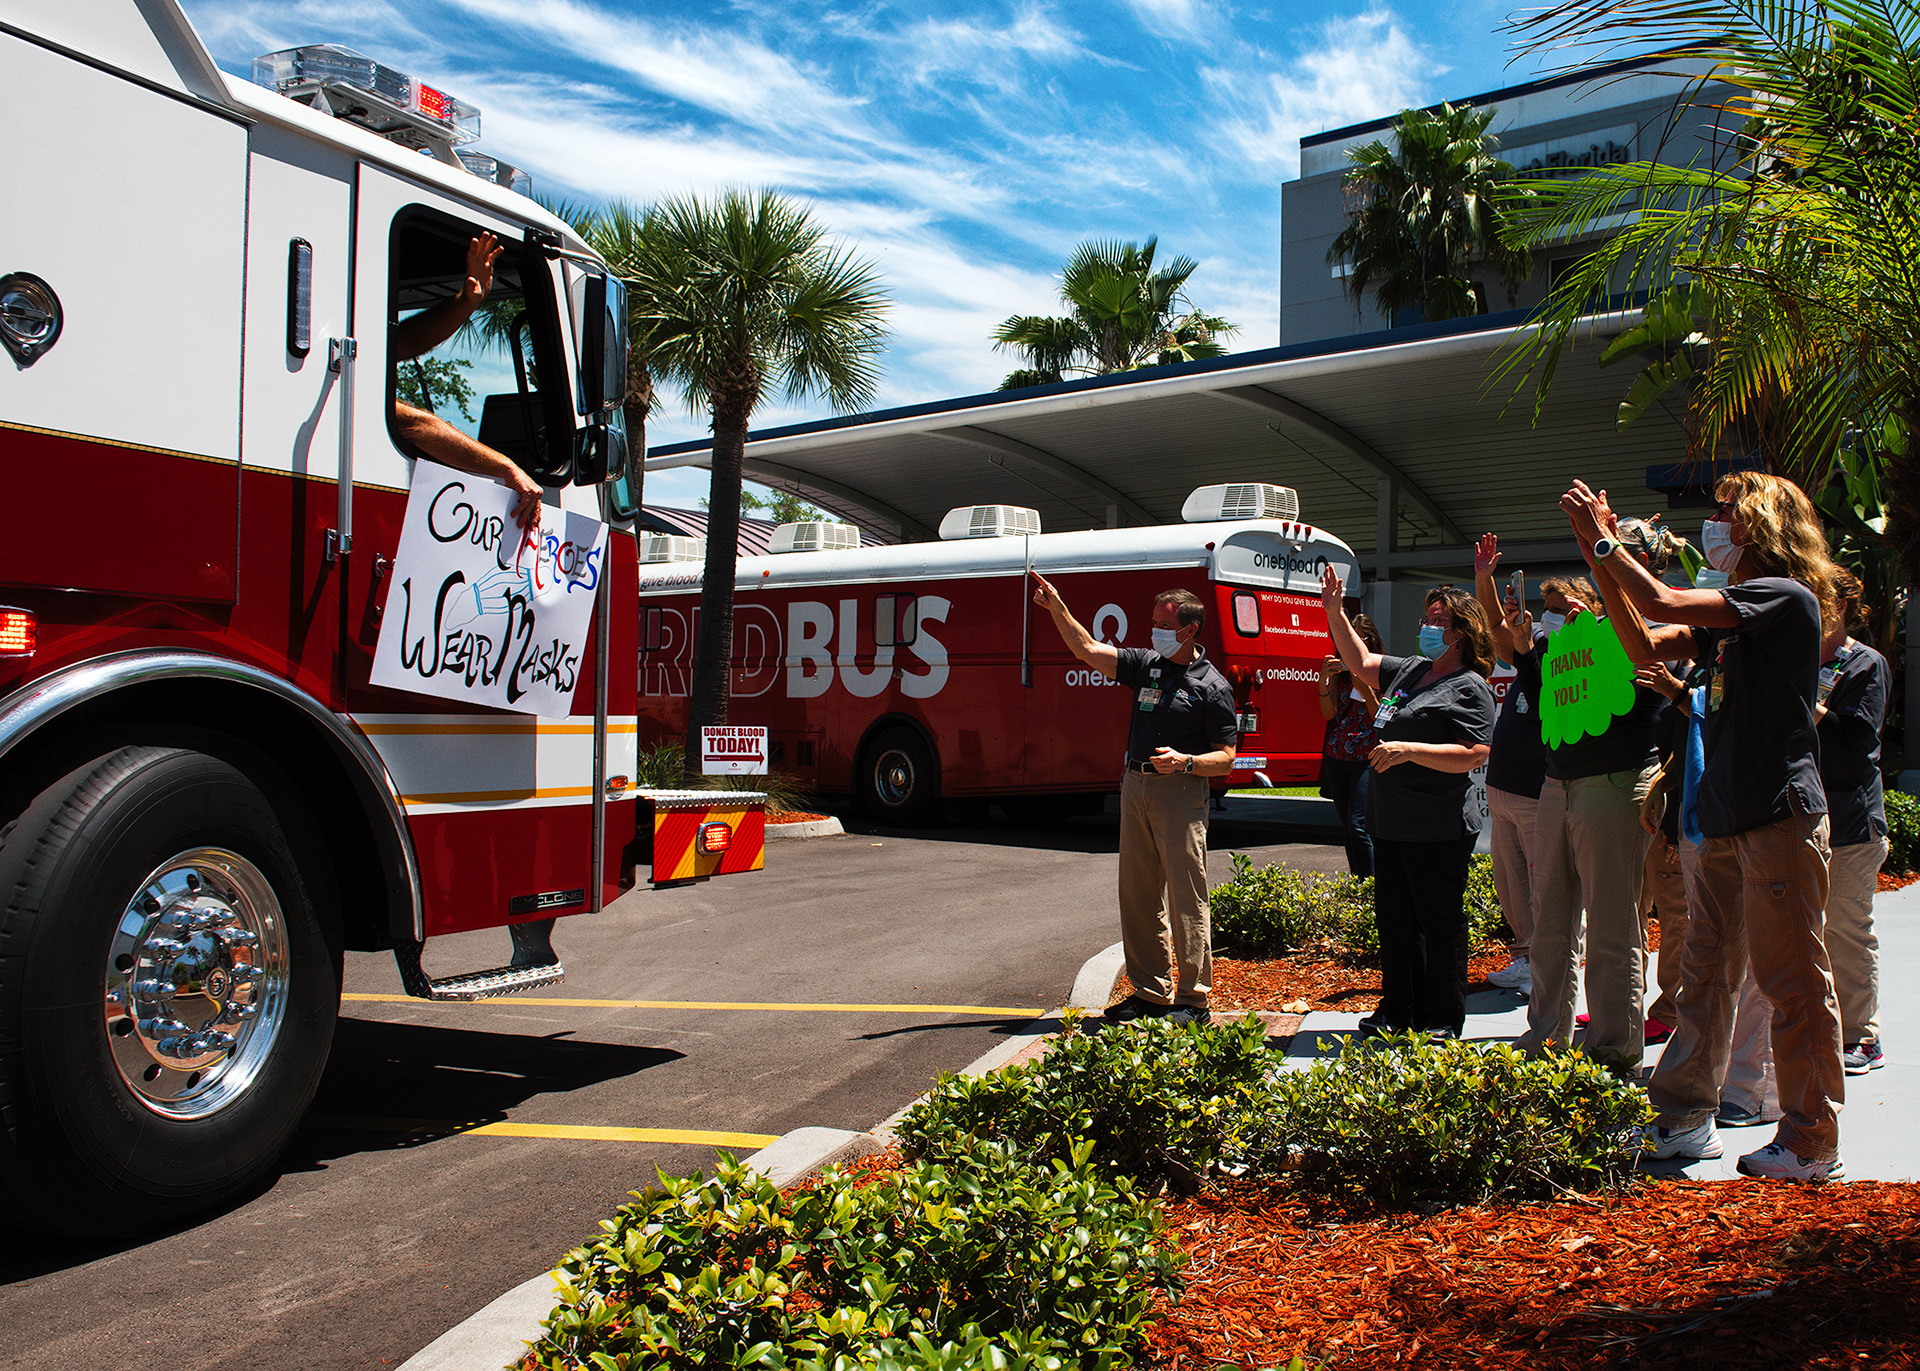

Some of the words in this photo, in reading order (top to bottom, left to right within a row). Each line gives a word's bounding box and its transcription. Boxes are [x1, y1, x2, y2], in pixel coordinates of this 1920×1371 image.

[1545, 141, 1629, 177] Florida
[428, 481, 511, 571] OUR
[516, 524, 601, 593] HEROES
[1254, 553, 1313, 574] oneblood
[641, 574, 665, 592] give
[665, 570, 702, 586] blood
[1261, 594, 1273, 602] WHY
[1273, 595, 1282, 603] DO
[1282, 596, 1293, 605] YOU
[1294, 597, 1305, 606] GIVE
[401, 570, 497, 688] WEAR
[495, 587, 578, 704] MASKS
[1264, 625, 1328, 637] facebook.com/myoneblood
[1550, 647, 1594, 678] THANK
[1267, 668, 1320, 682] oneblood.o
[704, 727, 736, 737] DONATE
[738, 727, 765, 737] BLOOD
[707, 737, 760, 753] TODAY!
